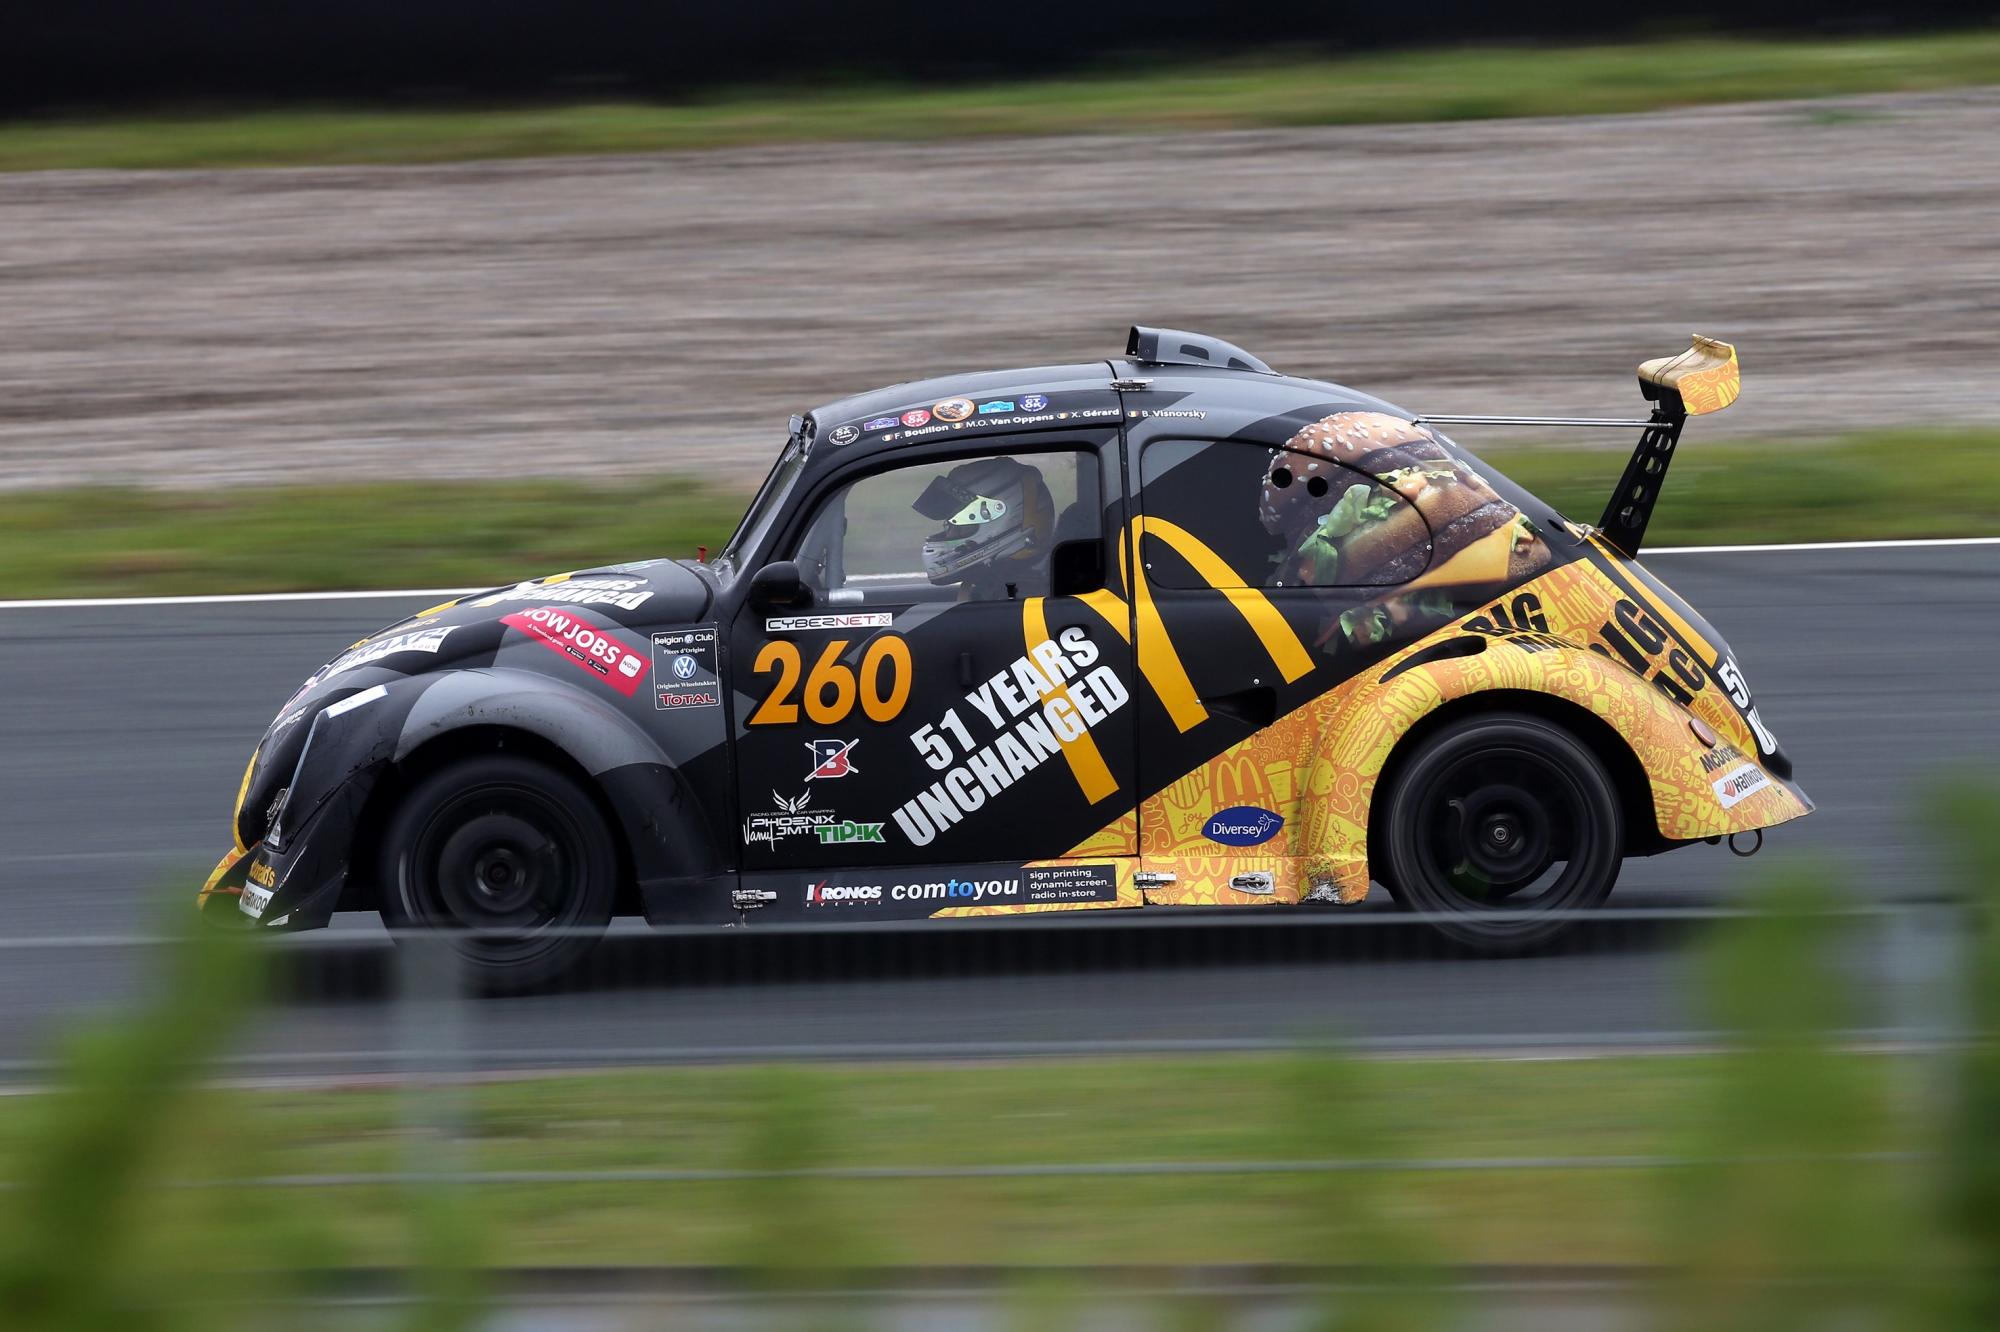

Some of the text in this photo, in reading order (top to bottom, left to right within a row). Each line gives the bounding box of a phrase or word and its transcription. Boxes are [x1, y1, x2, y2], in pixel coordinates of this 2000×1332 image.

[966, 413, 1054, 428] M.O. Van Oppens
[1071, 408, 1120, 419] X. Gérard
[1142, 410, 1207, 420] B. Visnovsky
[894, 424, 949, 440] F. Bouillon
[1460, 592, 1550, 638] BIG
[655, 633, 714, 646] Belgian Club
[623, 660, 638, 672] NOW
[656, 682, 680, 690] Originele
[749, 635, 913, 726] 260
[1387, 676, 1406, 699] GIVE
[909, 626, 1100, 771] 51 YEARS
[1697, 697, 1727, 730] SHARE
[891, 665, 1131, 847] UNCHANGED
[751, 815, 836, 828] PHOENIX
[1178, 812, 1207, 835] joy
[1212, 823, 1264, 838] Diversey
[1030, 871, 1050, 879] sign
[806, 880, 882, 902] KRONOS
[891, 878, 1019, 901] comtoyou
[1030, 881, 1073, 890] dynamic
[1031, 891, 1056, 899] radio
